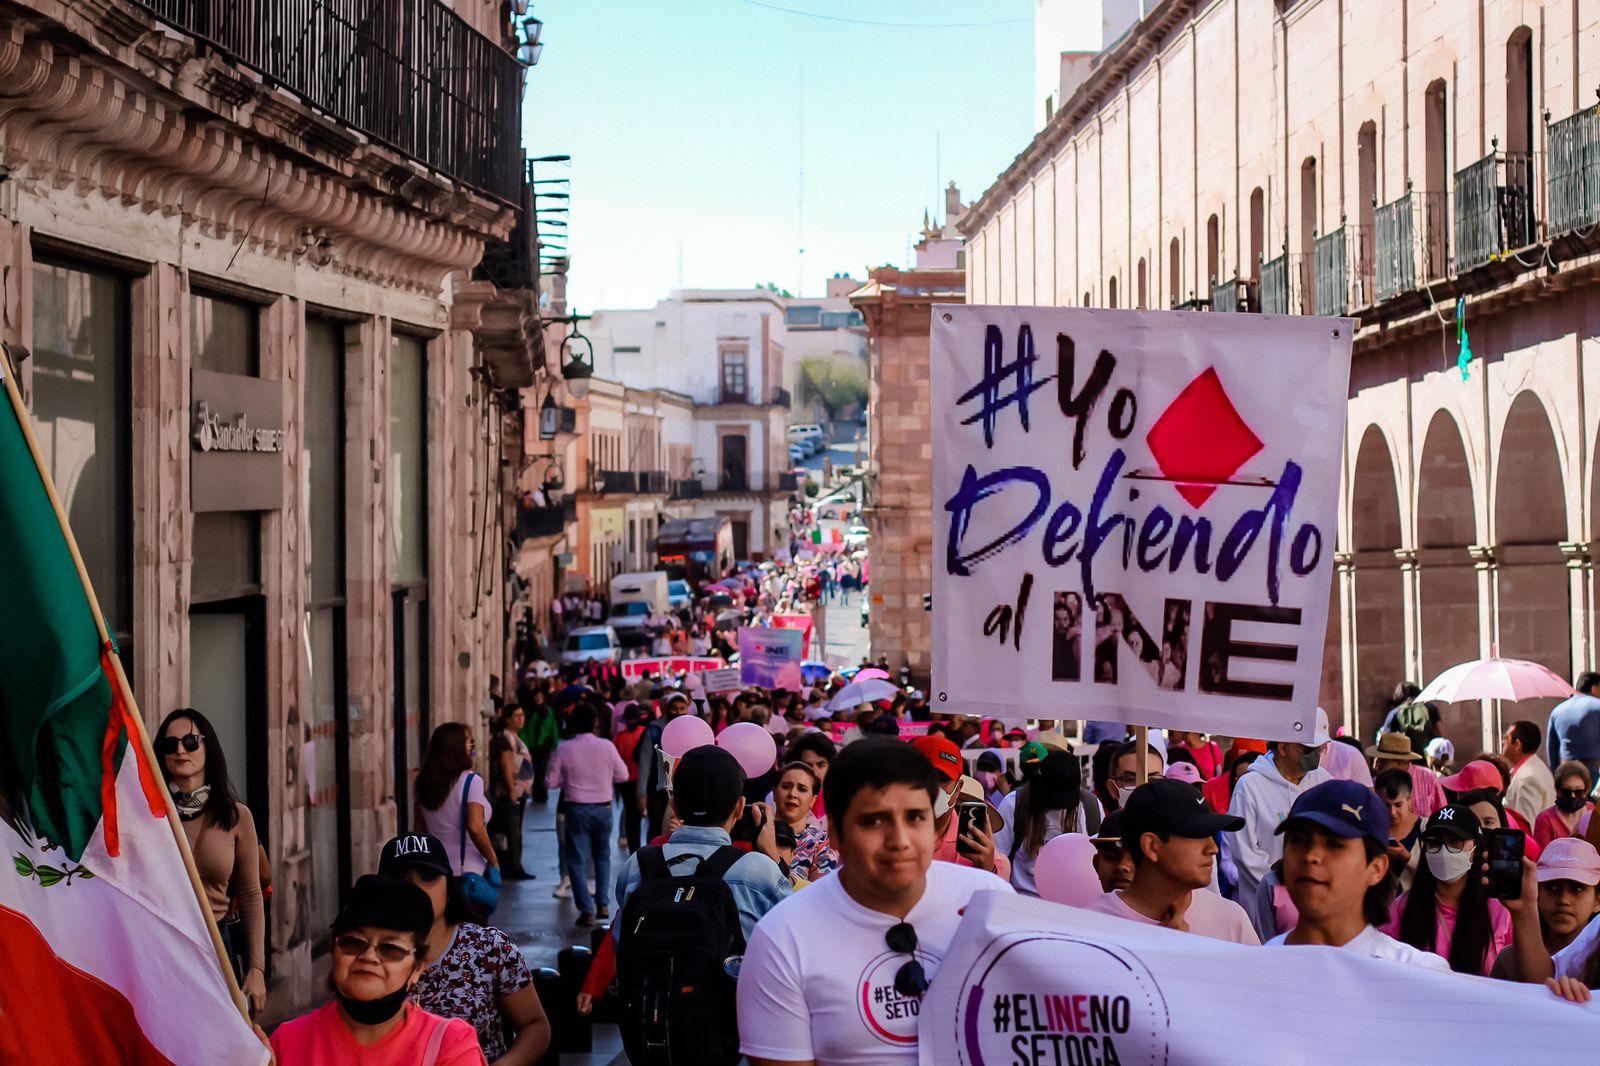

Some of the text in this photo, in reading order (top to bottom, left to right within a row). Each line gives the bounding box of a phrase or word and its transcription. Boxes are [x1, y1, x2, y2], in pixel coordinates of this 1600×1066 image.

[956, 322, 1138, 470] #Yo
[213, 412, 254, 451] Santander
[945, 447, 1322, 611] Defiendo
[983, 572, 1303, 702] al INE
[394, 835, 431, 857] MM
[993, 993, 1130, 1034] #ELINENO
[1011, 1034, 1121, 1066] SETOCA
